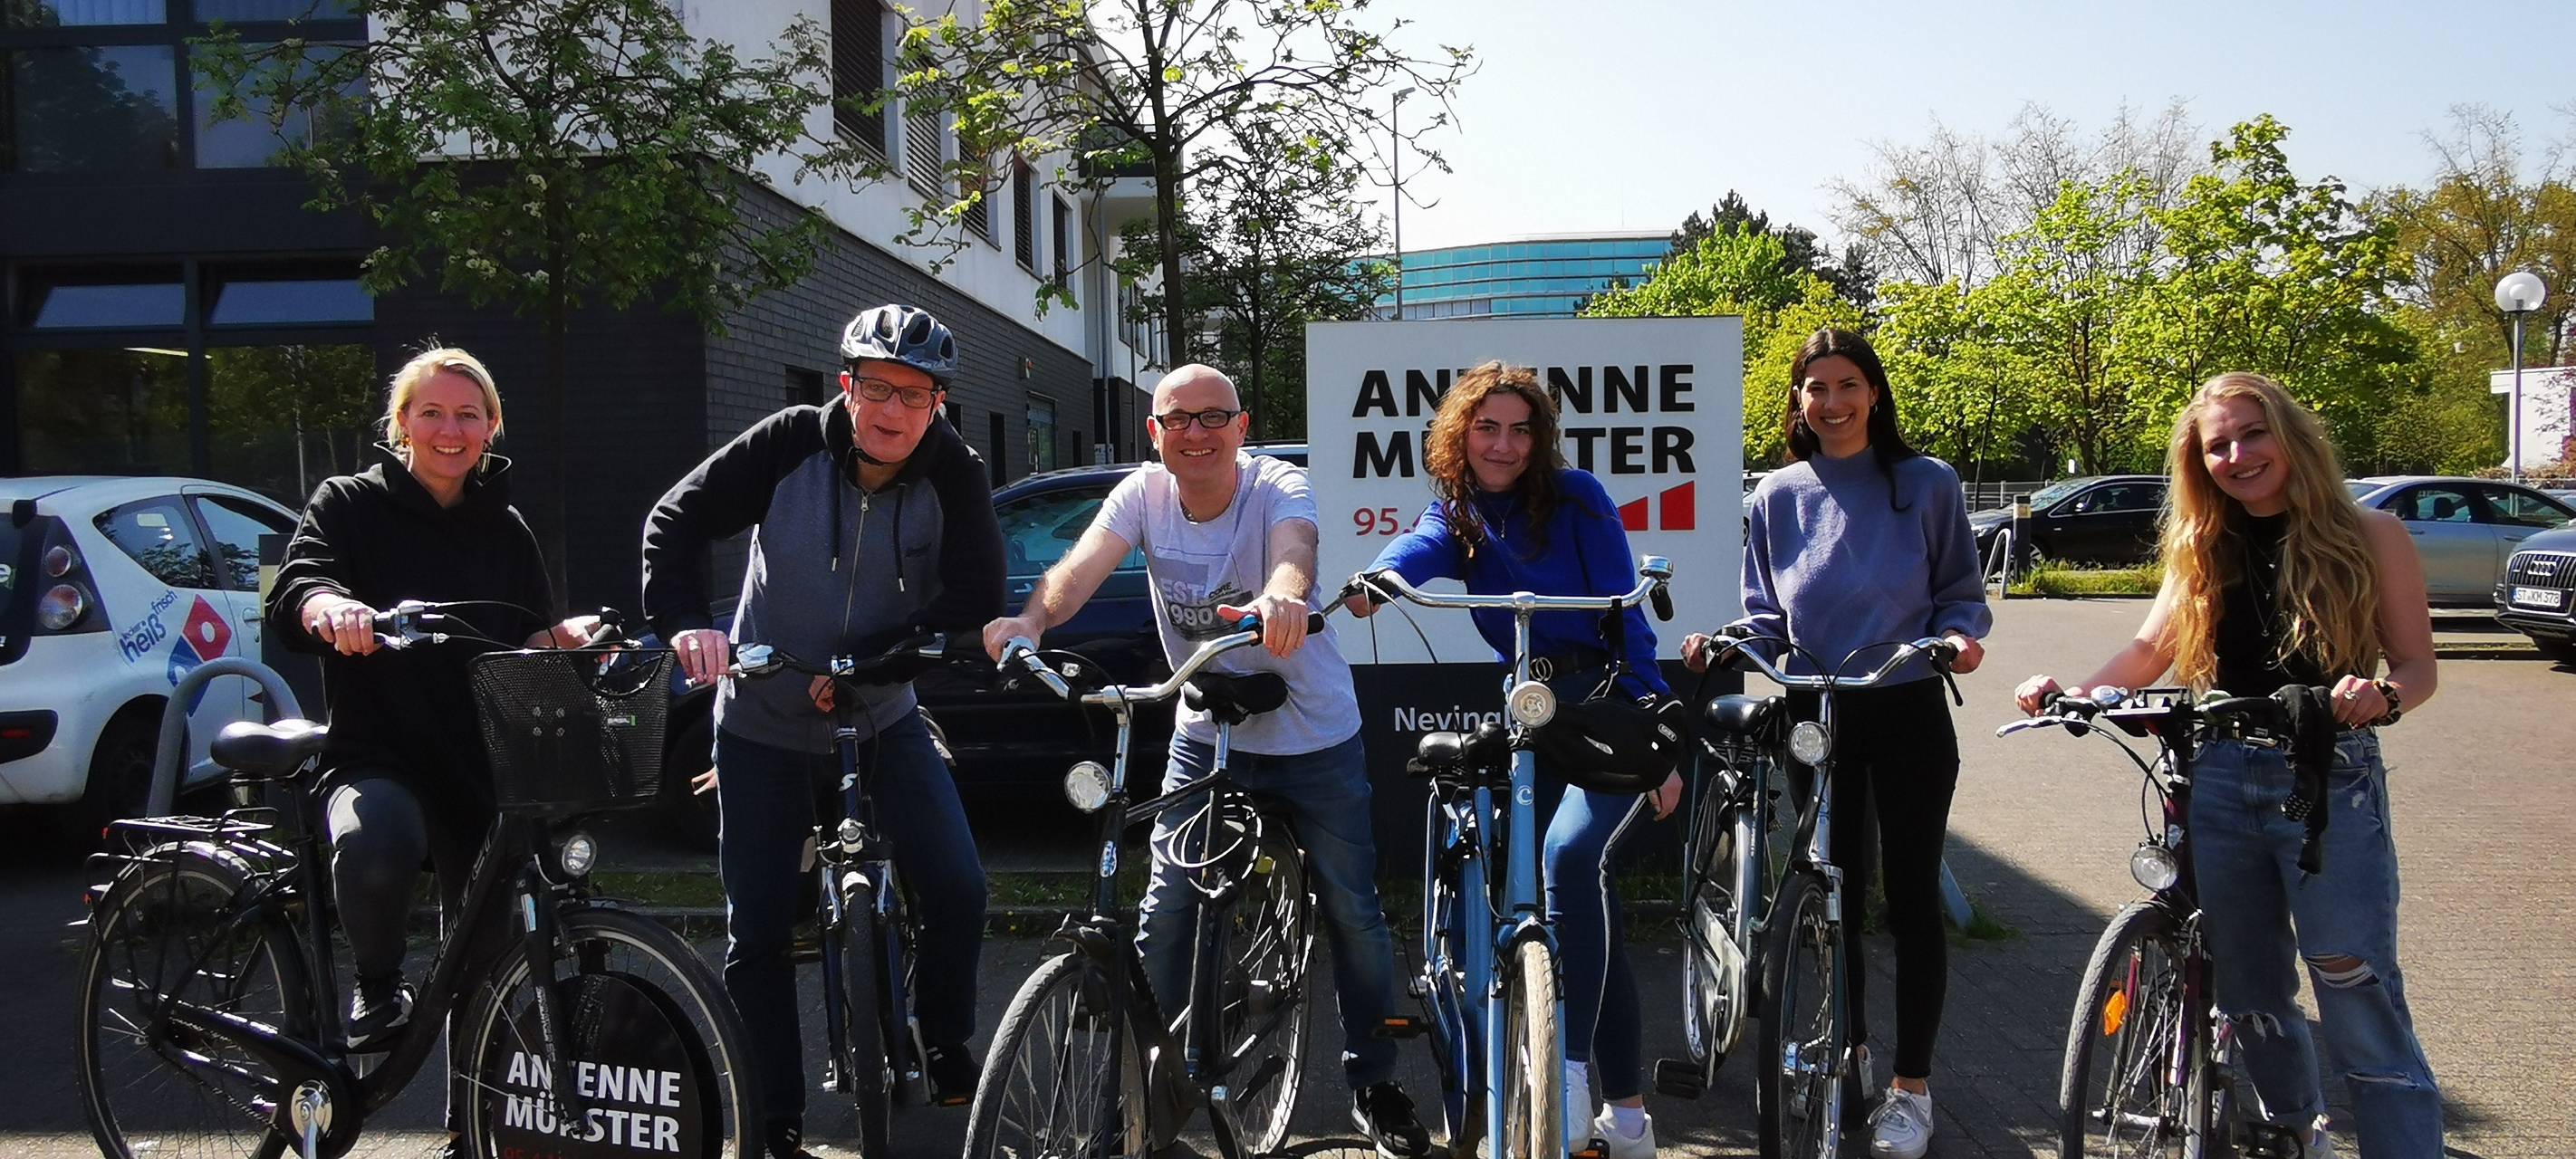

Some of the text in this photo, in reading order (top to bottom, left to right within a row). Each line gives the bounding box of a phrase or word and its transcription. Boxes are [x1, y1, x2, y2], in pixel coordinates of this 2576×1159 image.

[1352, 364, 1696, 418] ANNNE
[1352, 420, 1697, 479] MTER
[1353, 507, 1428, 536] 95.
[119, 613, 167, 663] heiß
[507, 1051, 680, 1108] ANENNE
